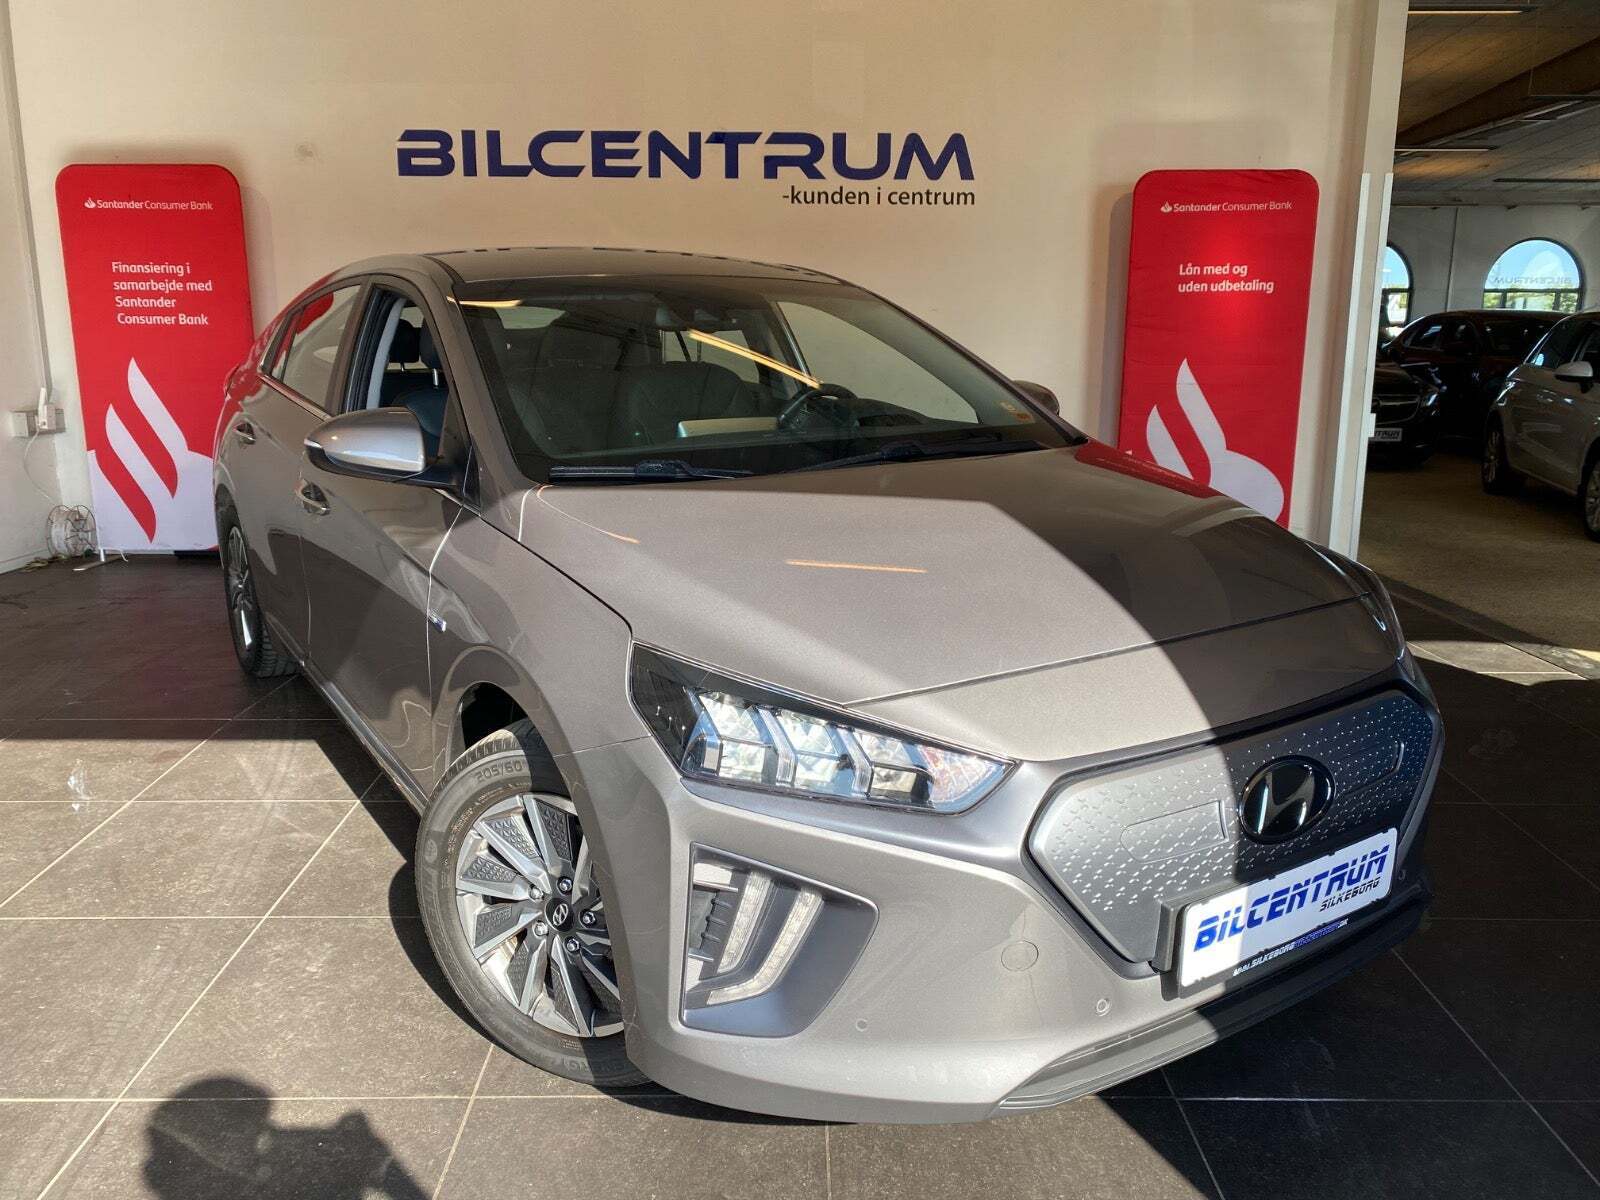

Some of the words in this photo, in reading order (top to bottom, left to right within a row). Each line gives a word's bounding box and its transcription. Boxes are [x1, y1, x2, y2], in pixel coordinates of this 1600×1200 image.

[396, 129, 975, 180] BILCENTRUM
[782, 185, 870, 205] -kunden
[876, 186, 882, 205] i
[887, 186, 976, 205] centrum
[97, 199, 144, 209] Santander
[144, 200, 189, 210] Consumer
[190, 201, 214, 210] Bank
[1173, 202, 1220, 212] Santander
[1222, 201, 1268, 211] Consumer
[1269, 200, 1293, 210] Bank
[111, 261, 184, 277] Finansiering
[186, 262, 191, 274] i
[1179, 263, 1200, 275] Lån
[1203, 263, 1230, 275] med
[1232, 264, 1248, 277] og
[113, 279, 184, 293] samarbejde
[186, 279, 213, 291] med
[1178, 281, 1208, 292] uden
[1210, 279, 1275, 294] udbetaling
[115, 296, 177, 308] Santander
[117, 313, 176, 325] Consumer
[178, 313, 209, 325] Bank
[1193, 844, 1390, 952] BILCENTRUM
[1319, 877, 1382, 912] SILKEBORG
